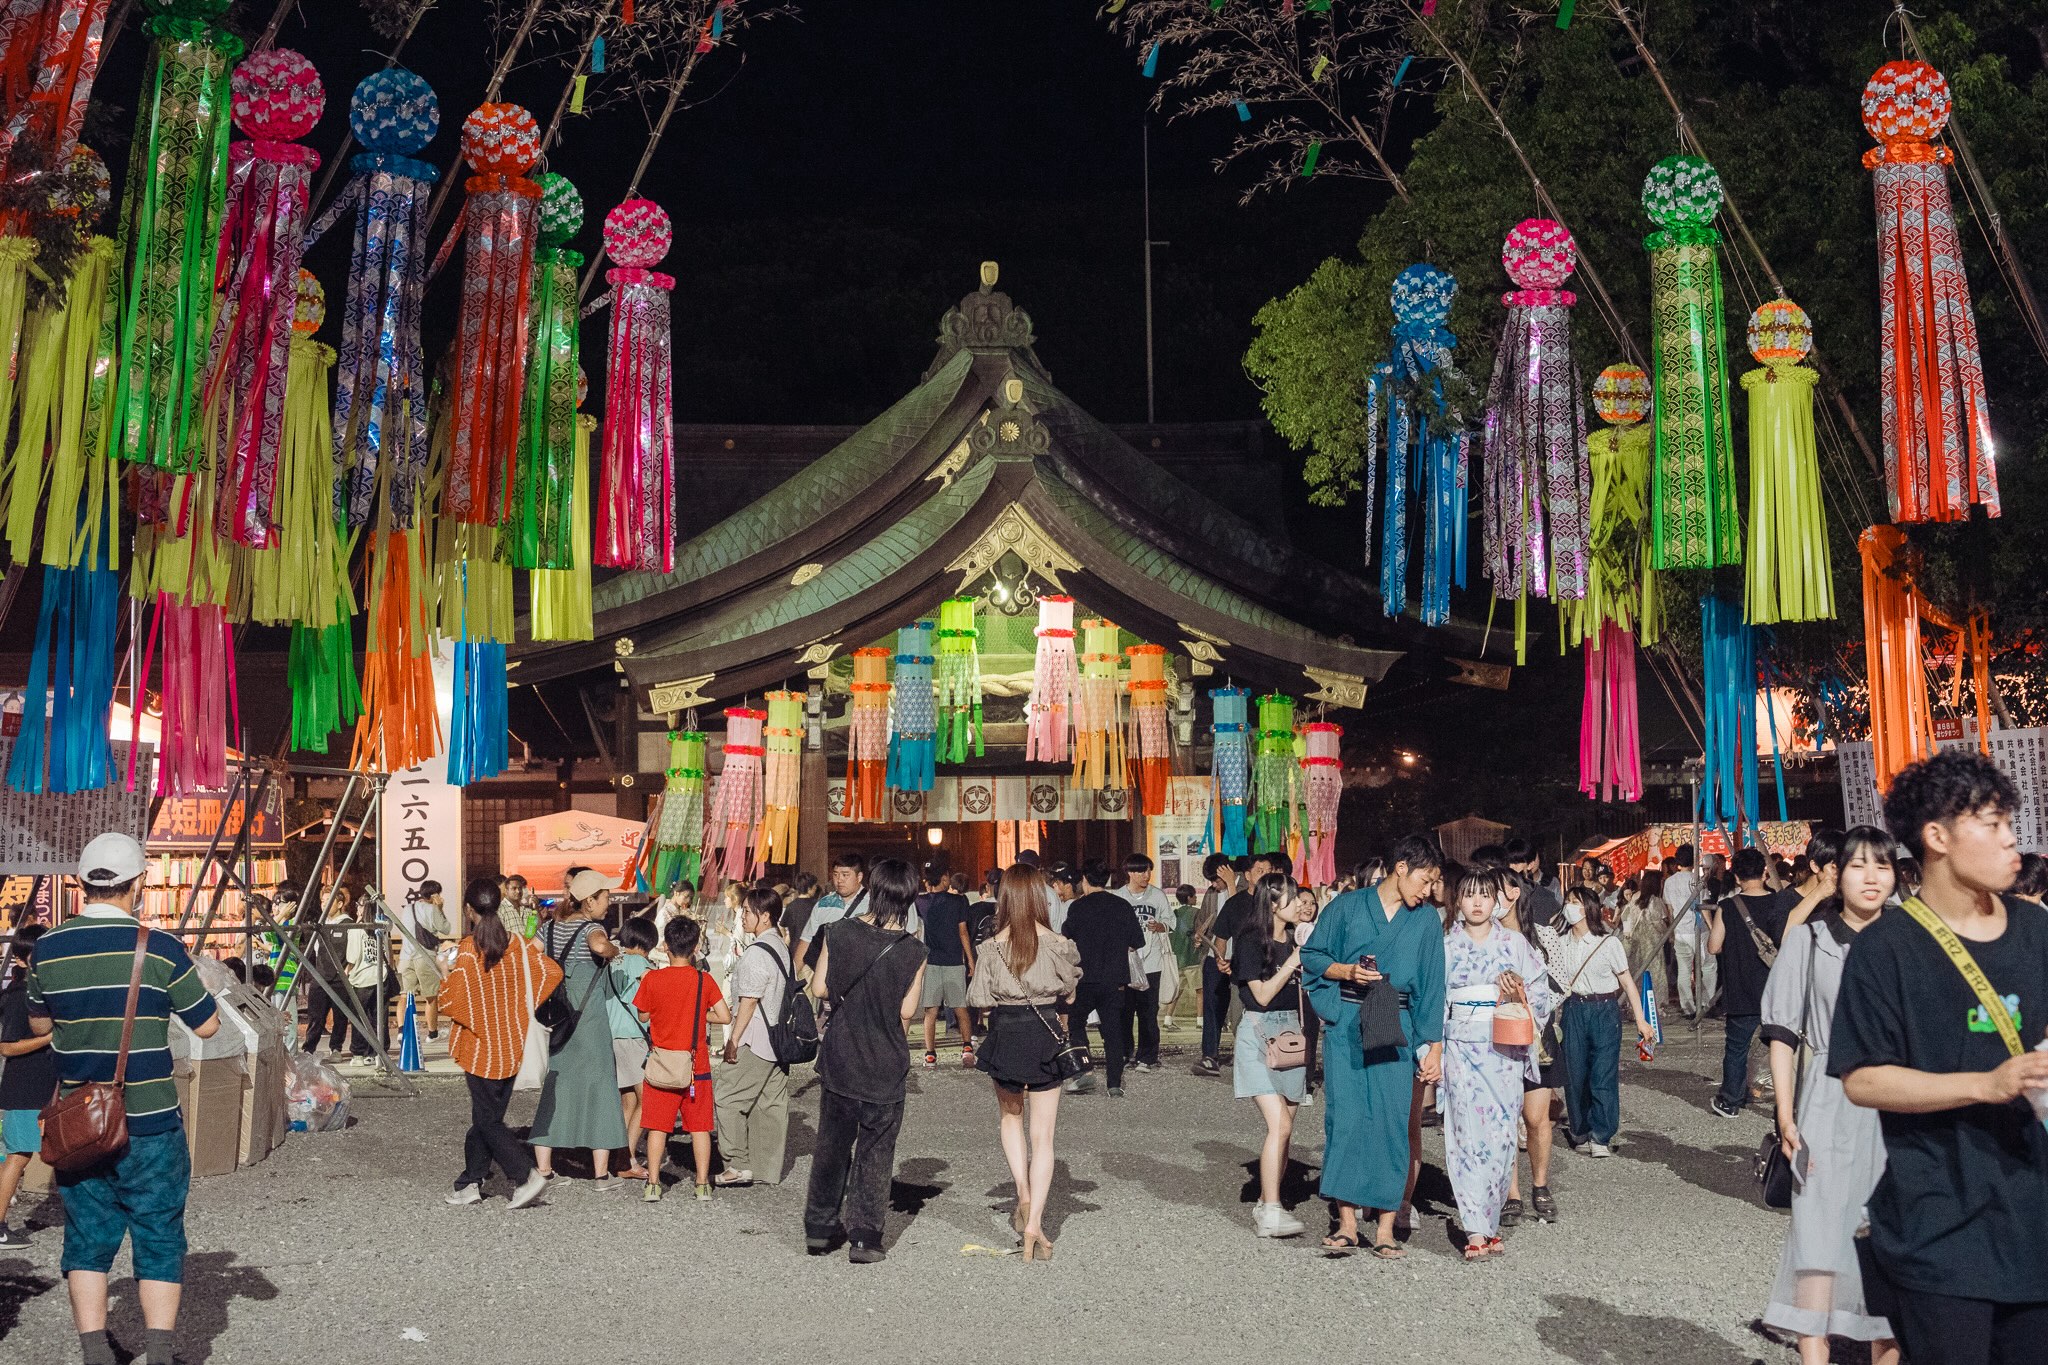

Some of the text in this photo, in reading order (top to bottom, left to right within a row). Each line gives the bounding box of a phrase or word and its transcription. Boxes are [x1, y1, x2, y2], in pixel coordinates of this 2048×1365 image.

[2007, 740, 2023, 846] 共和食品工式会社
[1662, 828, 1694, 848] まるご
[1767, 825, 1803, 845] まるごと
